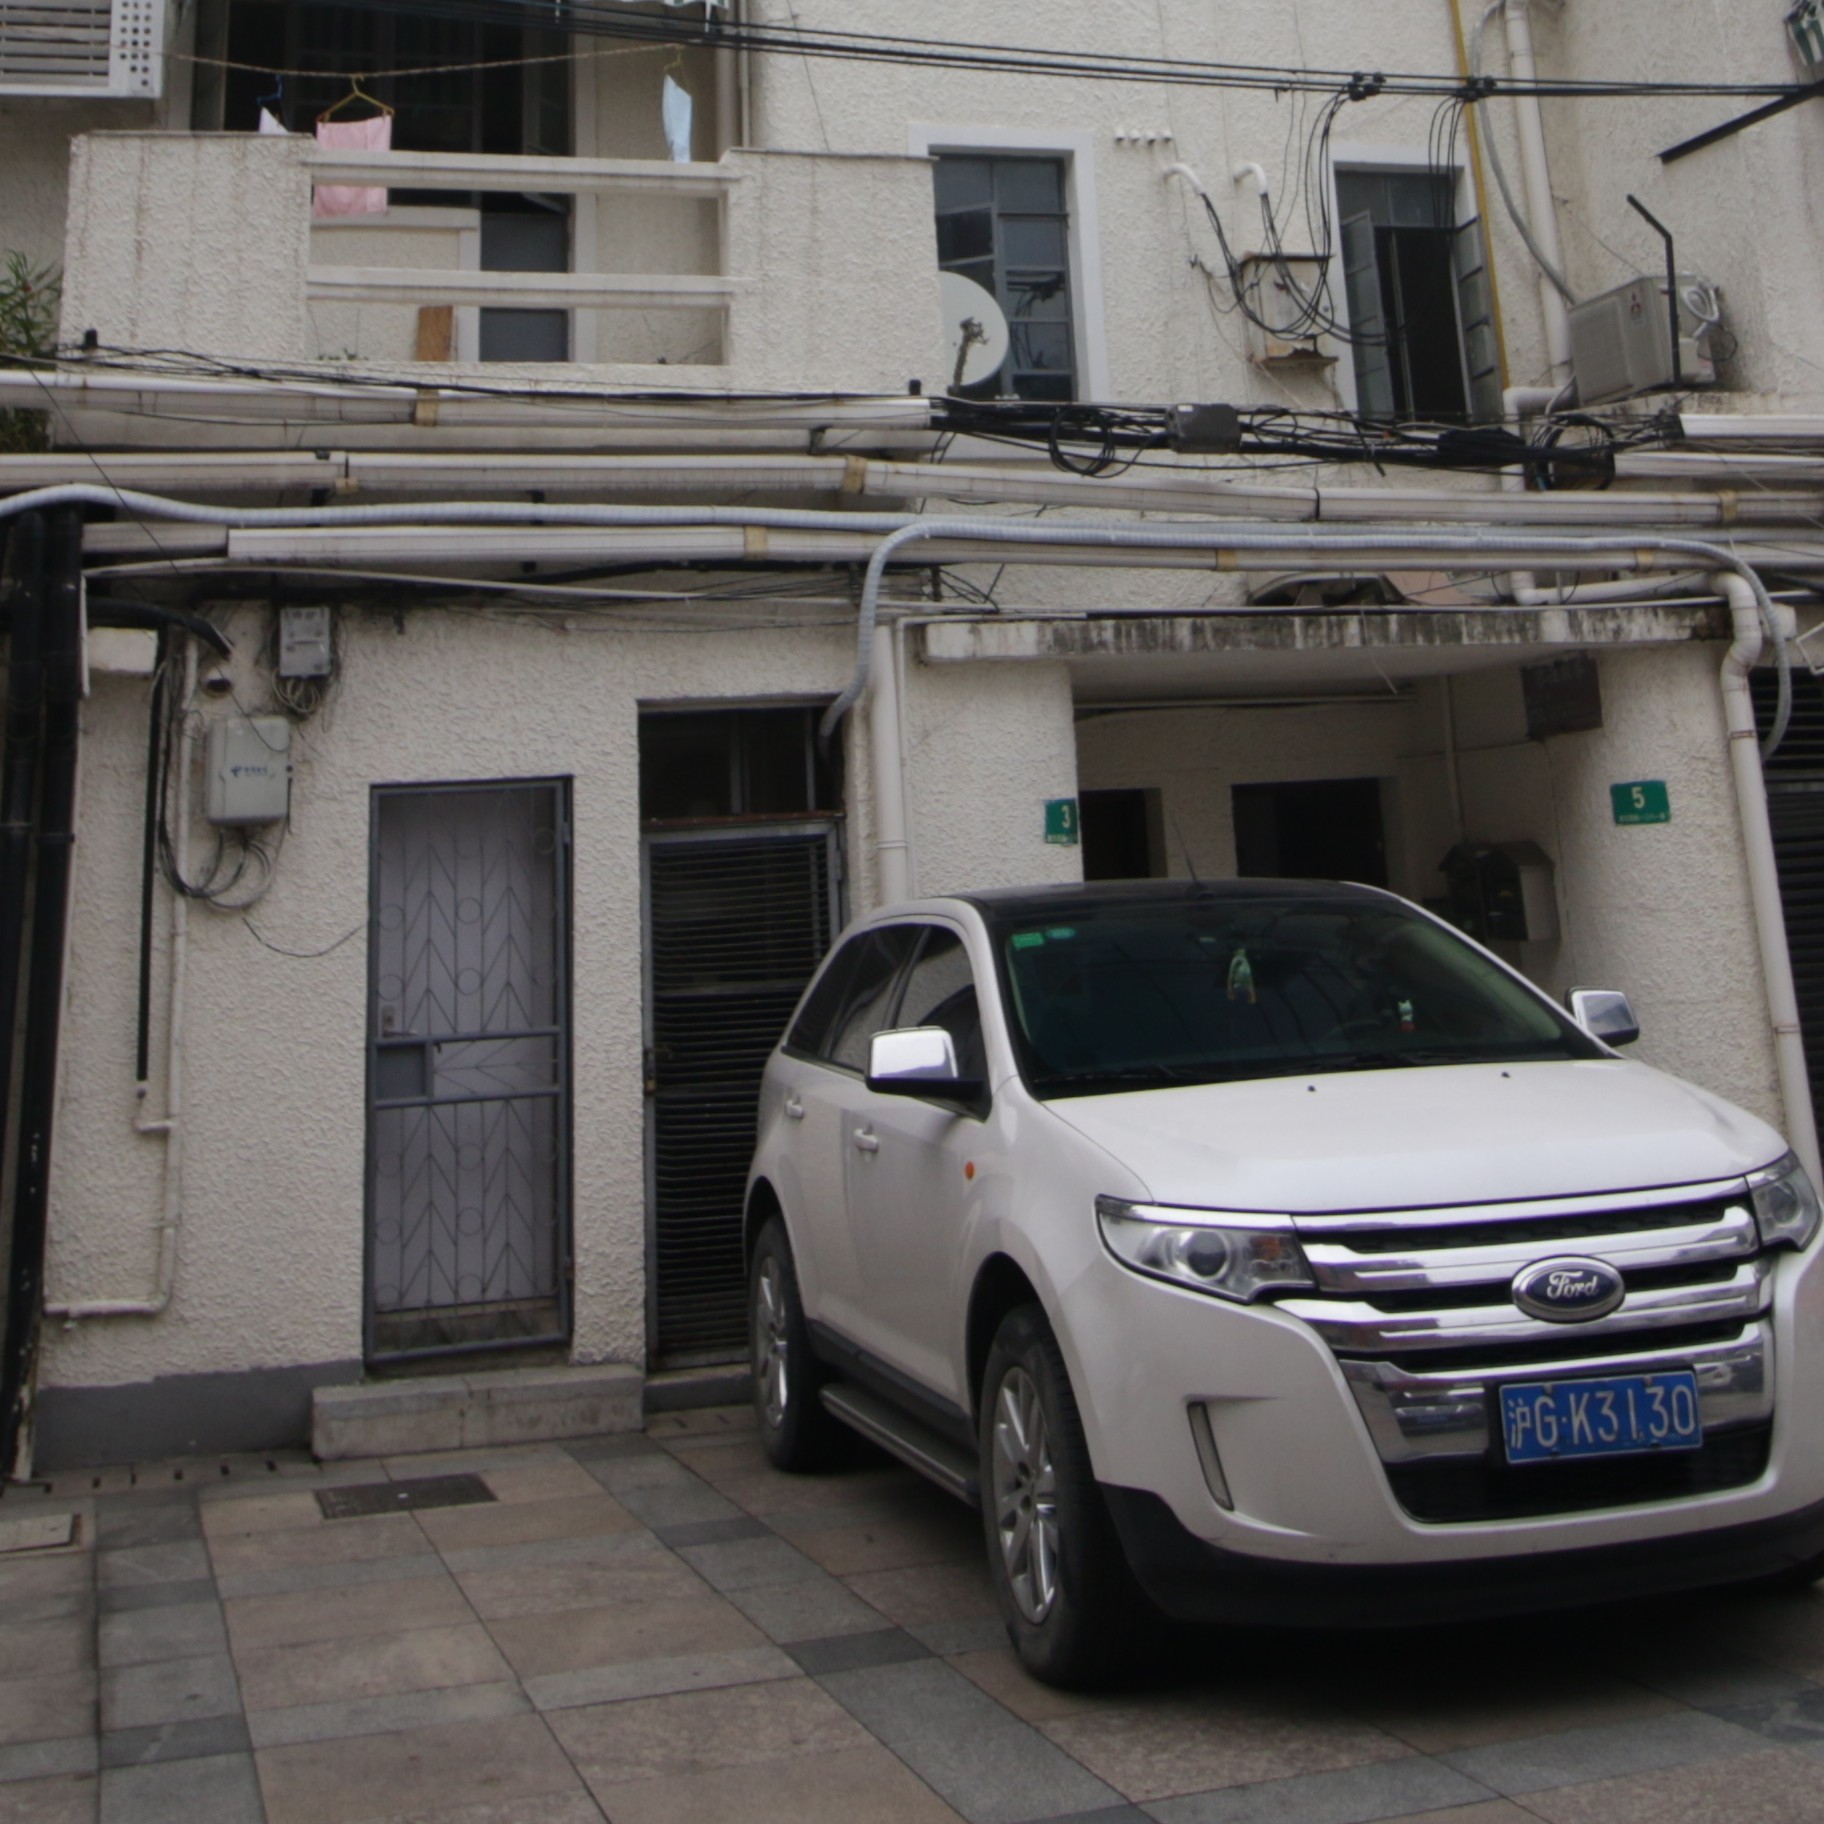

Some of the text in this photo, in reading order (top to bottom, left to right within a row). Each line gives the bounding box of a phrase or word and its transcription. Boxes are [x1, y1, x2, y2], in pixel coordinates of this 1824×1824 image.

[1631, 786, 1645, 809] 5
[1061, 804, 1071, 829] 3
[1546, 1270, 1599, 1300] Ford
